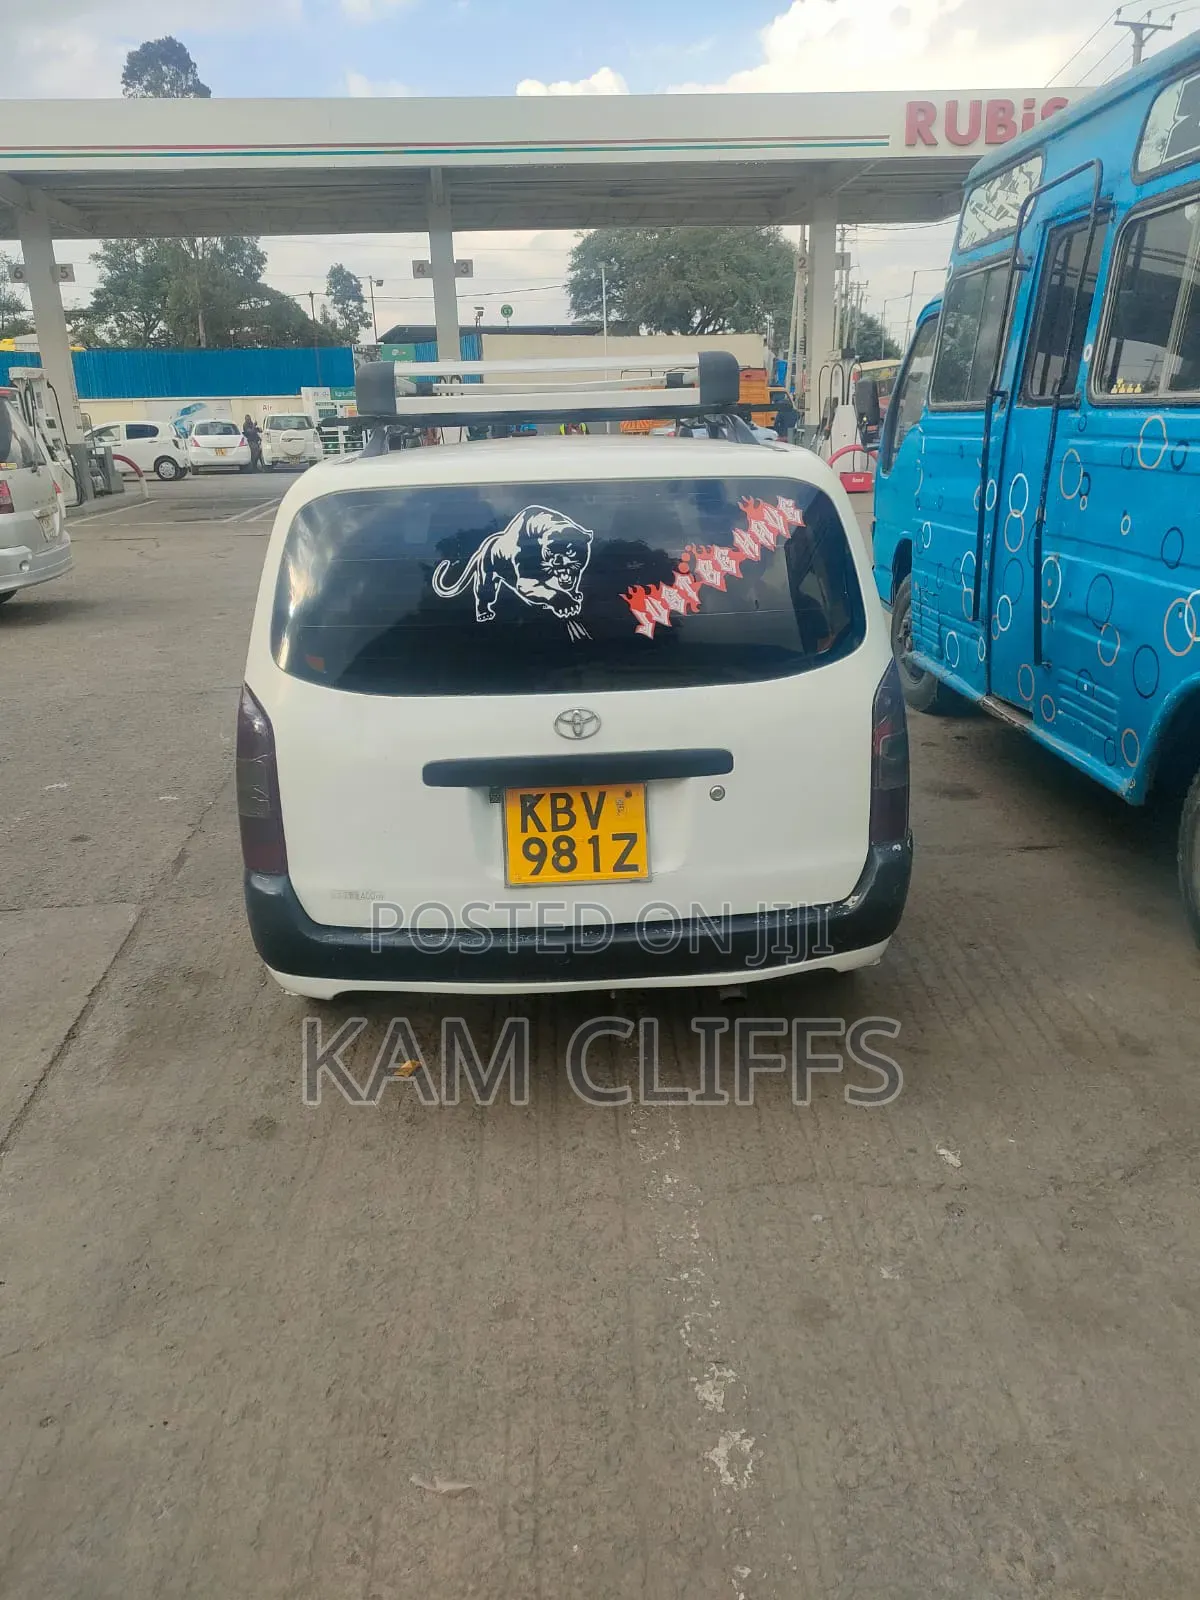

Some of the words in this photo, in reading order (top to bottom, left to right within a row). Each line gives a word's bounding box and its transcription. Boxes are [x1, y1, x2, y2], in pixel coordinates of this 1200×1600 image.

[416, 263, 426, 275] 4
[461, 263, 470, 275] 3
[798, 256, 807, 269] 2
[13, 266, 24, 280] 6
[60, 266, 69, 279] 5
[634, 572, 702, 640] JUST
[694, 543, 744, 593] BE
[519, 791, 607, 833] KBV
[522, 832, 640, 876] 981Z
